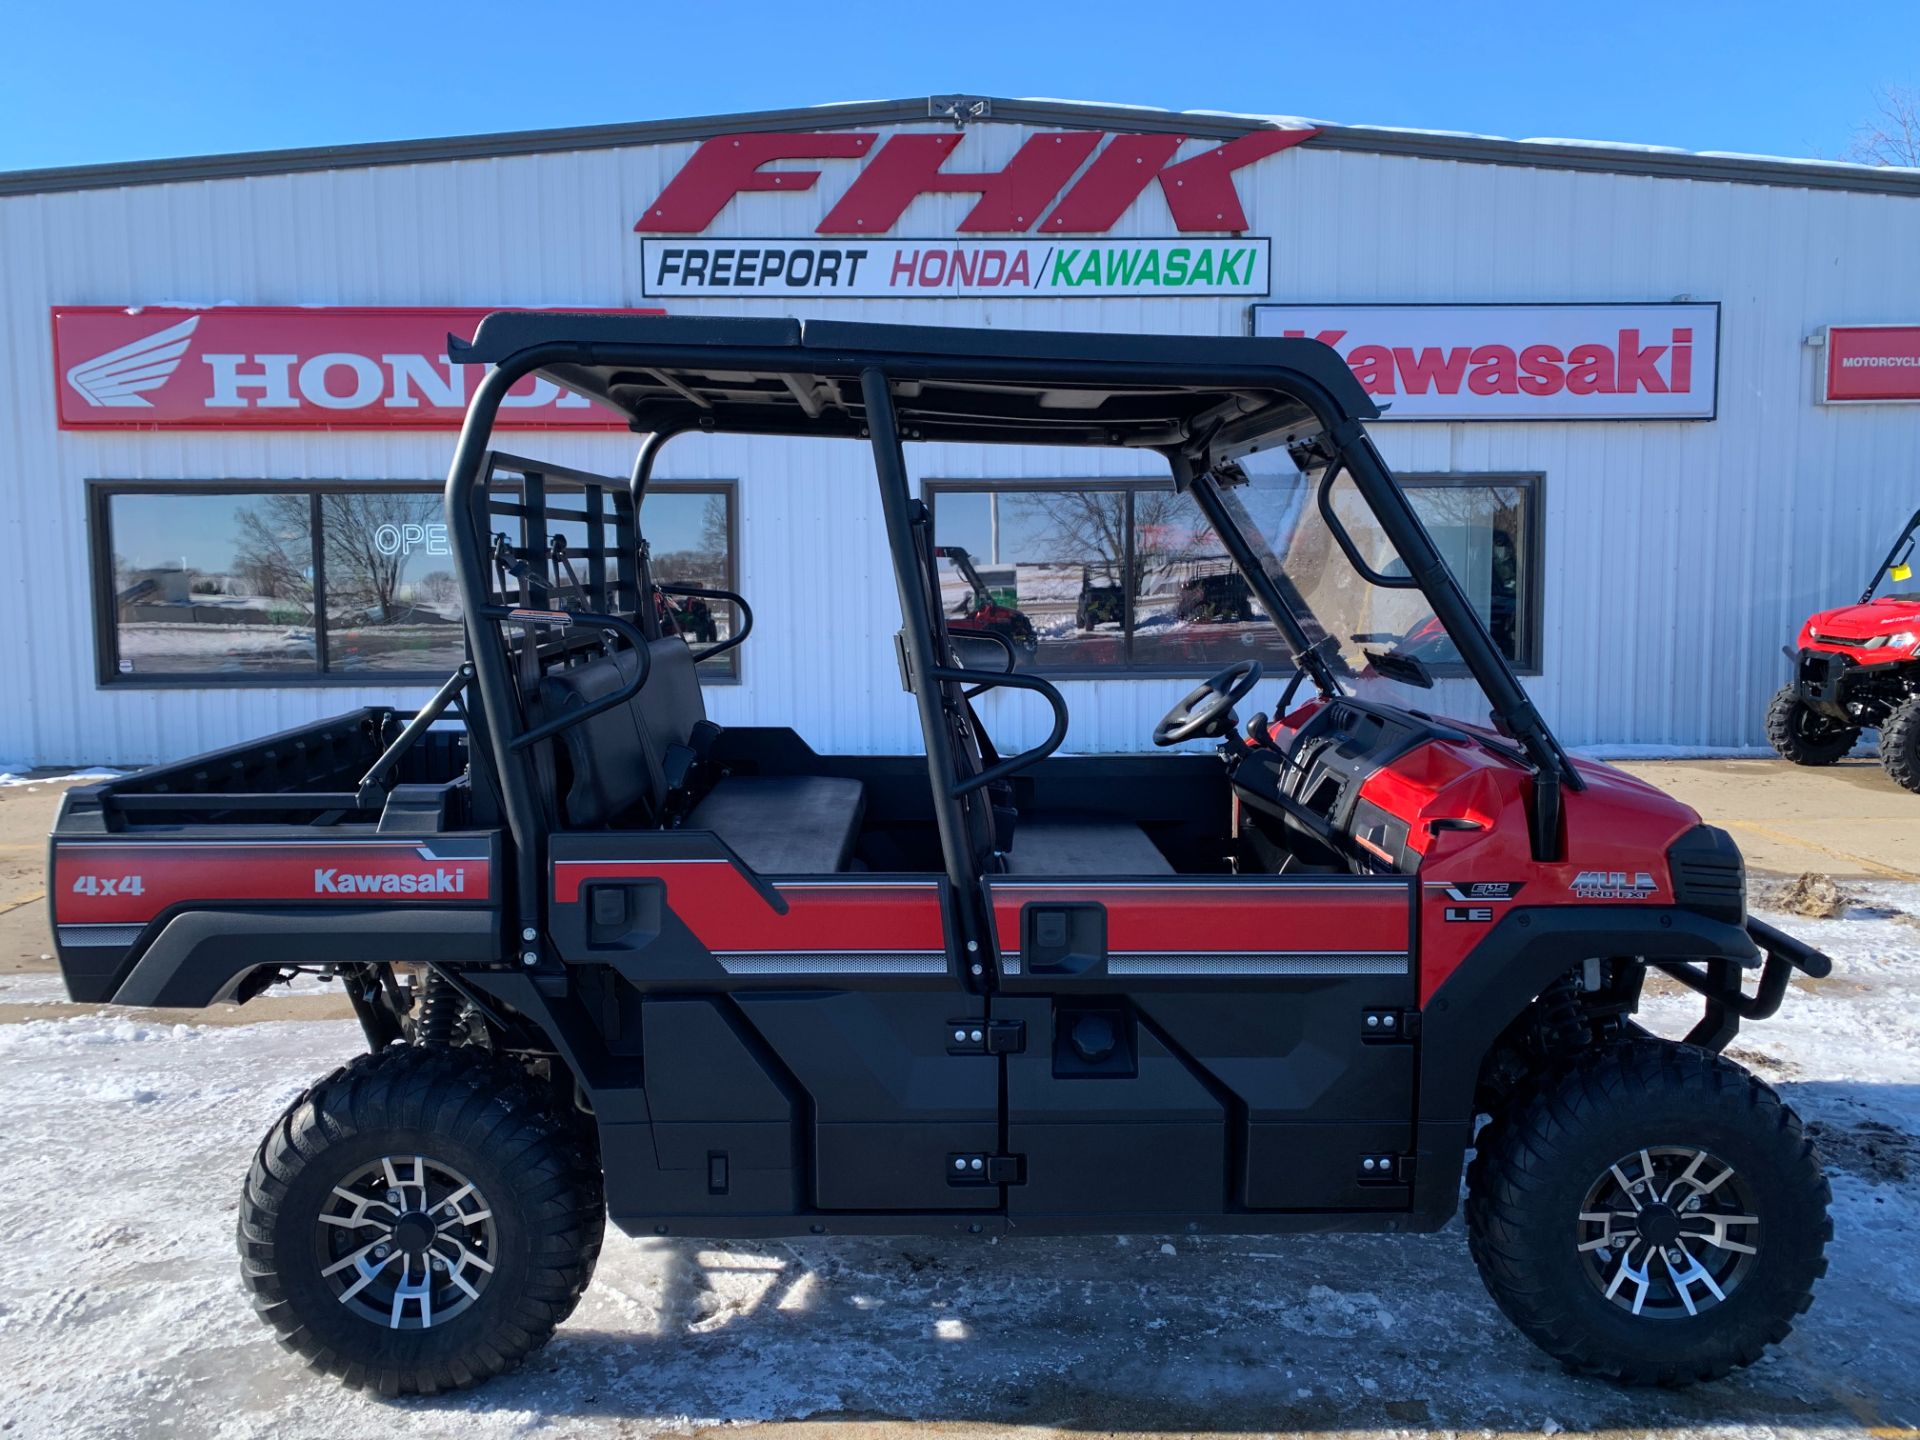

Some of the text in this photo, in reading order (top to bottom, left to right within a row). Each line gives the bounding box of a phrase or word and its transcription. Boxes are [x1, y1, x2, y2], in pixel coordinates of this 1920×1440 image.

[634, 129, 1323, 233] FHK
[656, 249, 868, 287] FREEPORT
[1283, 328, 1692, 396] awasaki
[202, 352, 591, 409] HON
[374, 523, 453, 555] OPE
[73, 875, 145, 896] 4x4
[314, 868, 465, 893] Kawasaki
[1446, 908, 1492, 921] LE
